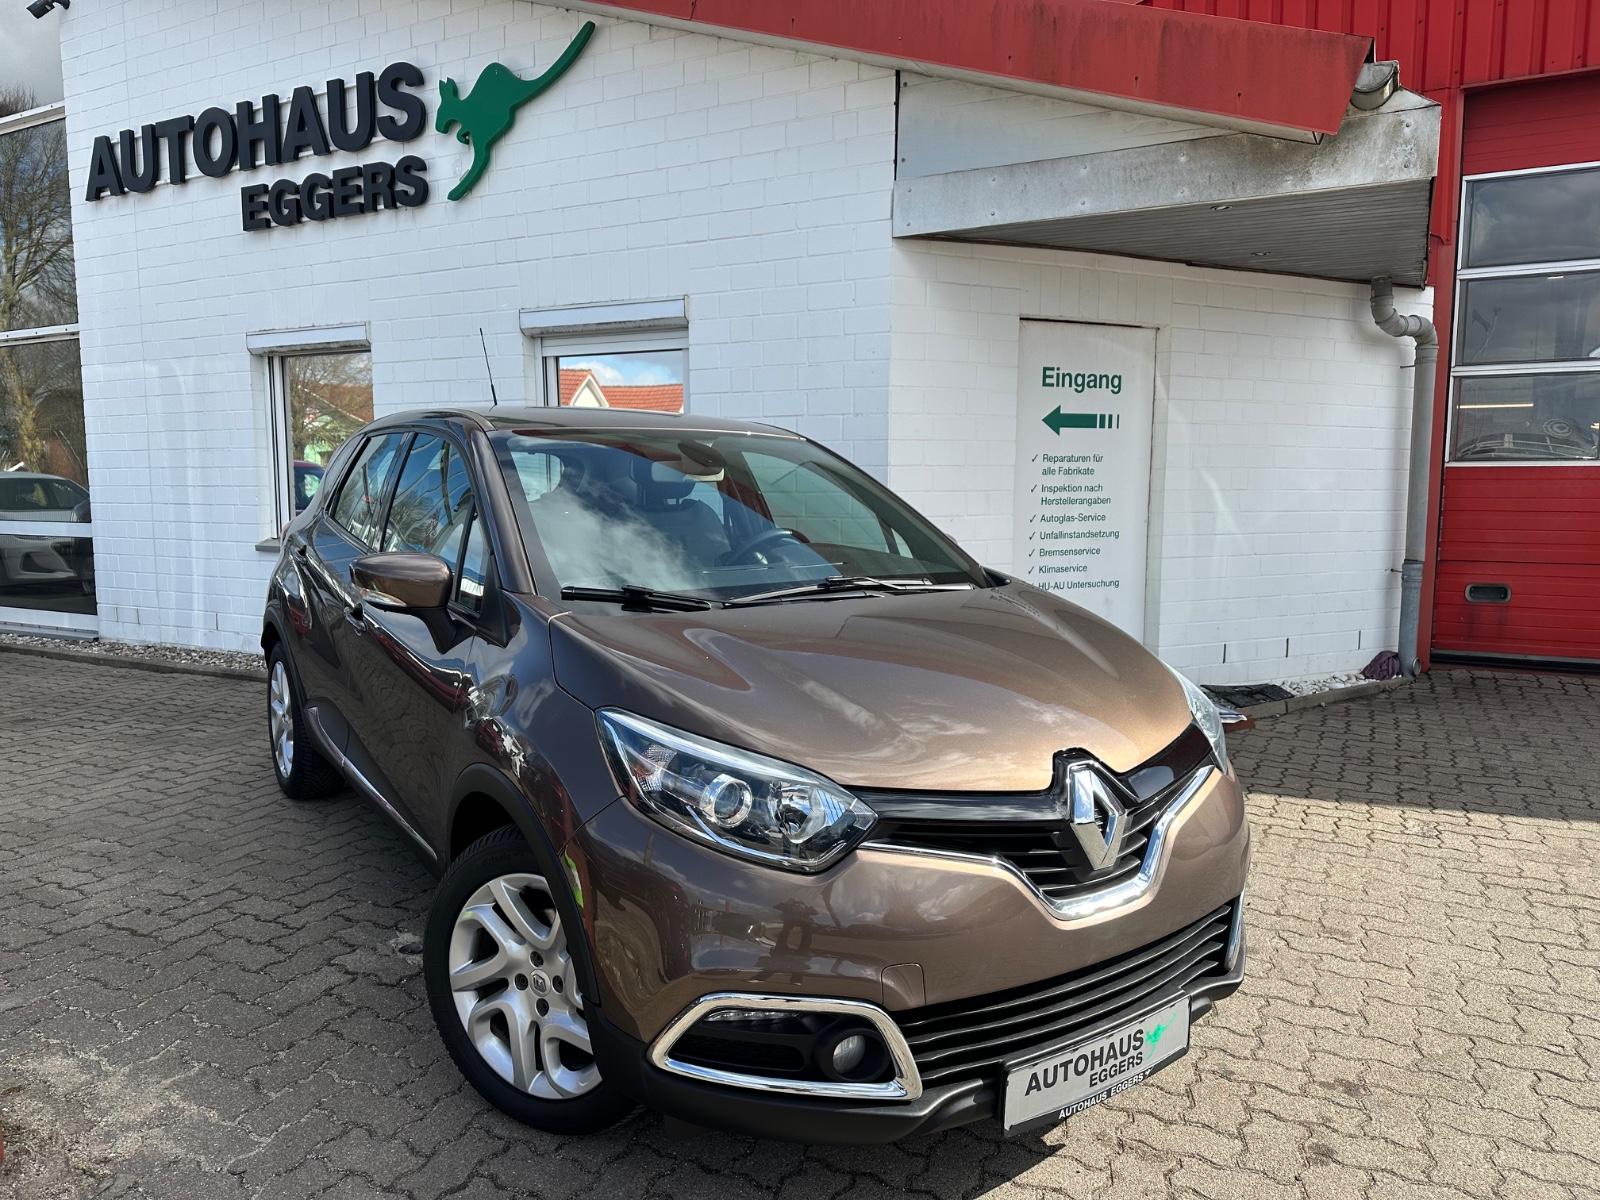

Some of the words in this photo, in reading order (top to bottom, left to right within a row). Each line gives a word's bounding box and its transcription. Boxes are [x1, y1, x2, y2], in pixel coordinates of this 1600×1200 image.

[86, 61, 426, 201] AUTOHAUS
[241, 155, 429, 232] EGGERS
[1041, 366, 1122, 394] Eingang
[1042, 453, 1091, 464] Reparaturen
[1092, 453, 1104, 463] für
[1041, 466, 1056, 476] alle
[1058, 466, 1095, 476] Fabrikate
[1041, 484, 1083, 495] Inspektion
[1084, 483, 1103, 493] nach
[1040, 496, 1111, 507] Herstellerangaben
[1040, 512, 1106, 524] Autoglas-Service
[1039, 529, 1120, 541] Unfallinstandsetzung
[1039, 547, 1101, 557] Bremsenservice
[1038, 563, 1088, 574] Klimaservice
[1066, 579, 1120, 590] Untersuchung
[1025, 1028, 1144, 1096] AUTOHAUS
[1089, 1052, 1143, 1088] EGGERS
[1058, 1091, 1108, 1119] AUTOHAUS
[1110, 1073, 1144, 1097] EGGERS
